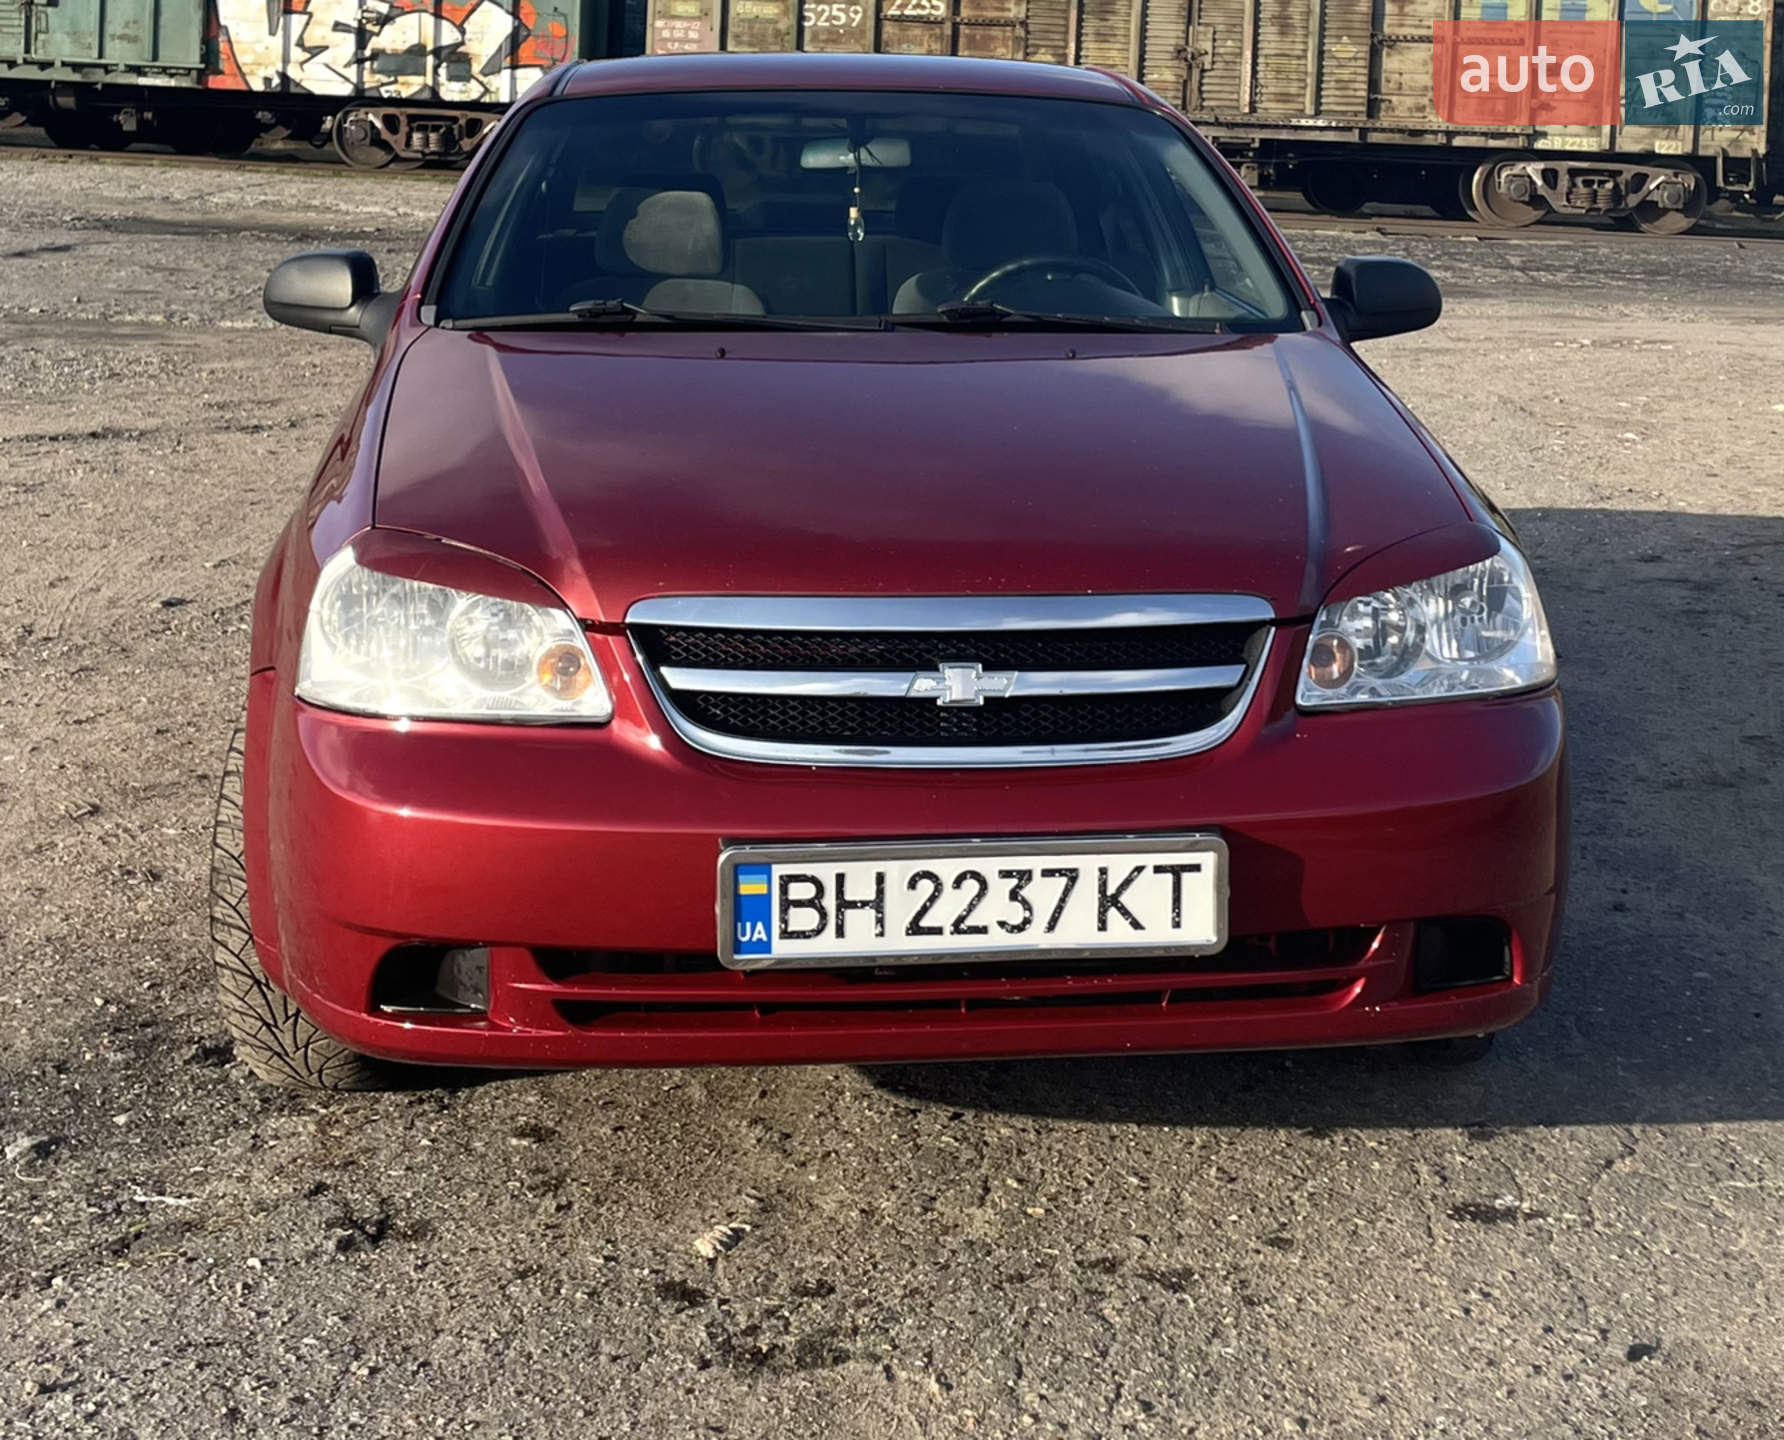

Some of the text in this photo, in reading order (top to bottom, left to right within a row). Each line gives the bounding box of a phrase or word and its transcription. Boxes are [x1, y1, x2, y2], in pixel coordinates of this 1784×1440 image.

[803, 3, 863, 27] 5259
[778, 863, 1203, 940] BH 2237 KT
[737, 921, 769, 942] UA
